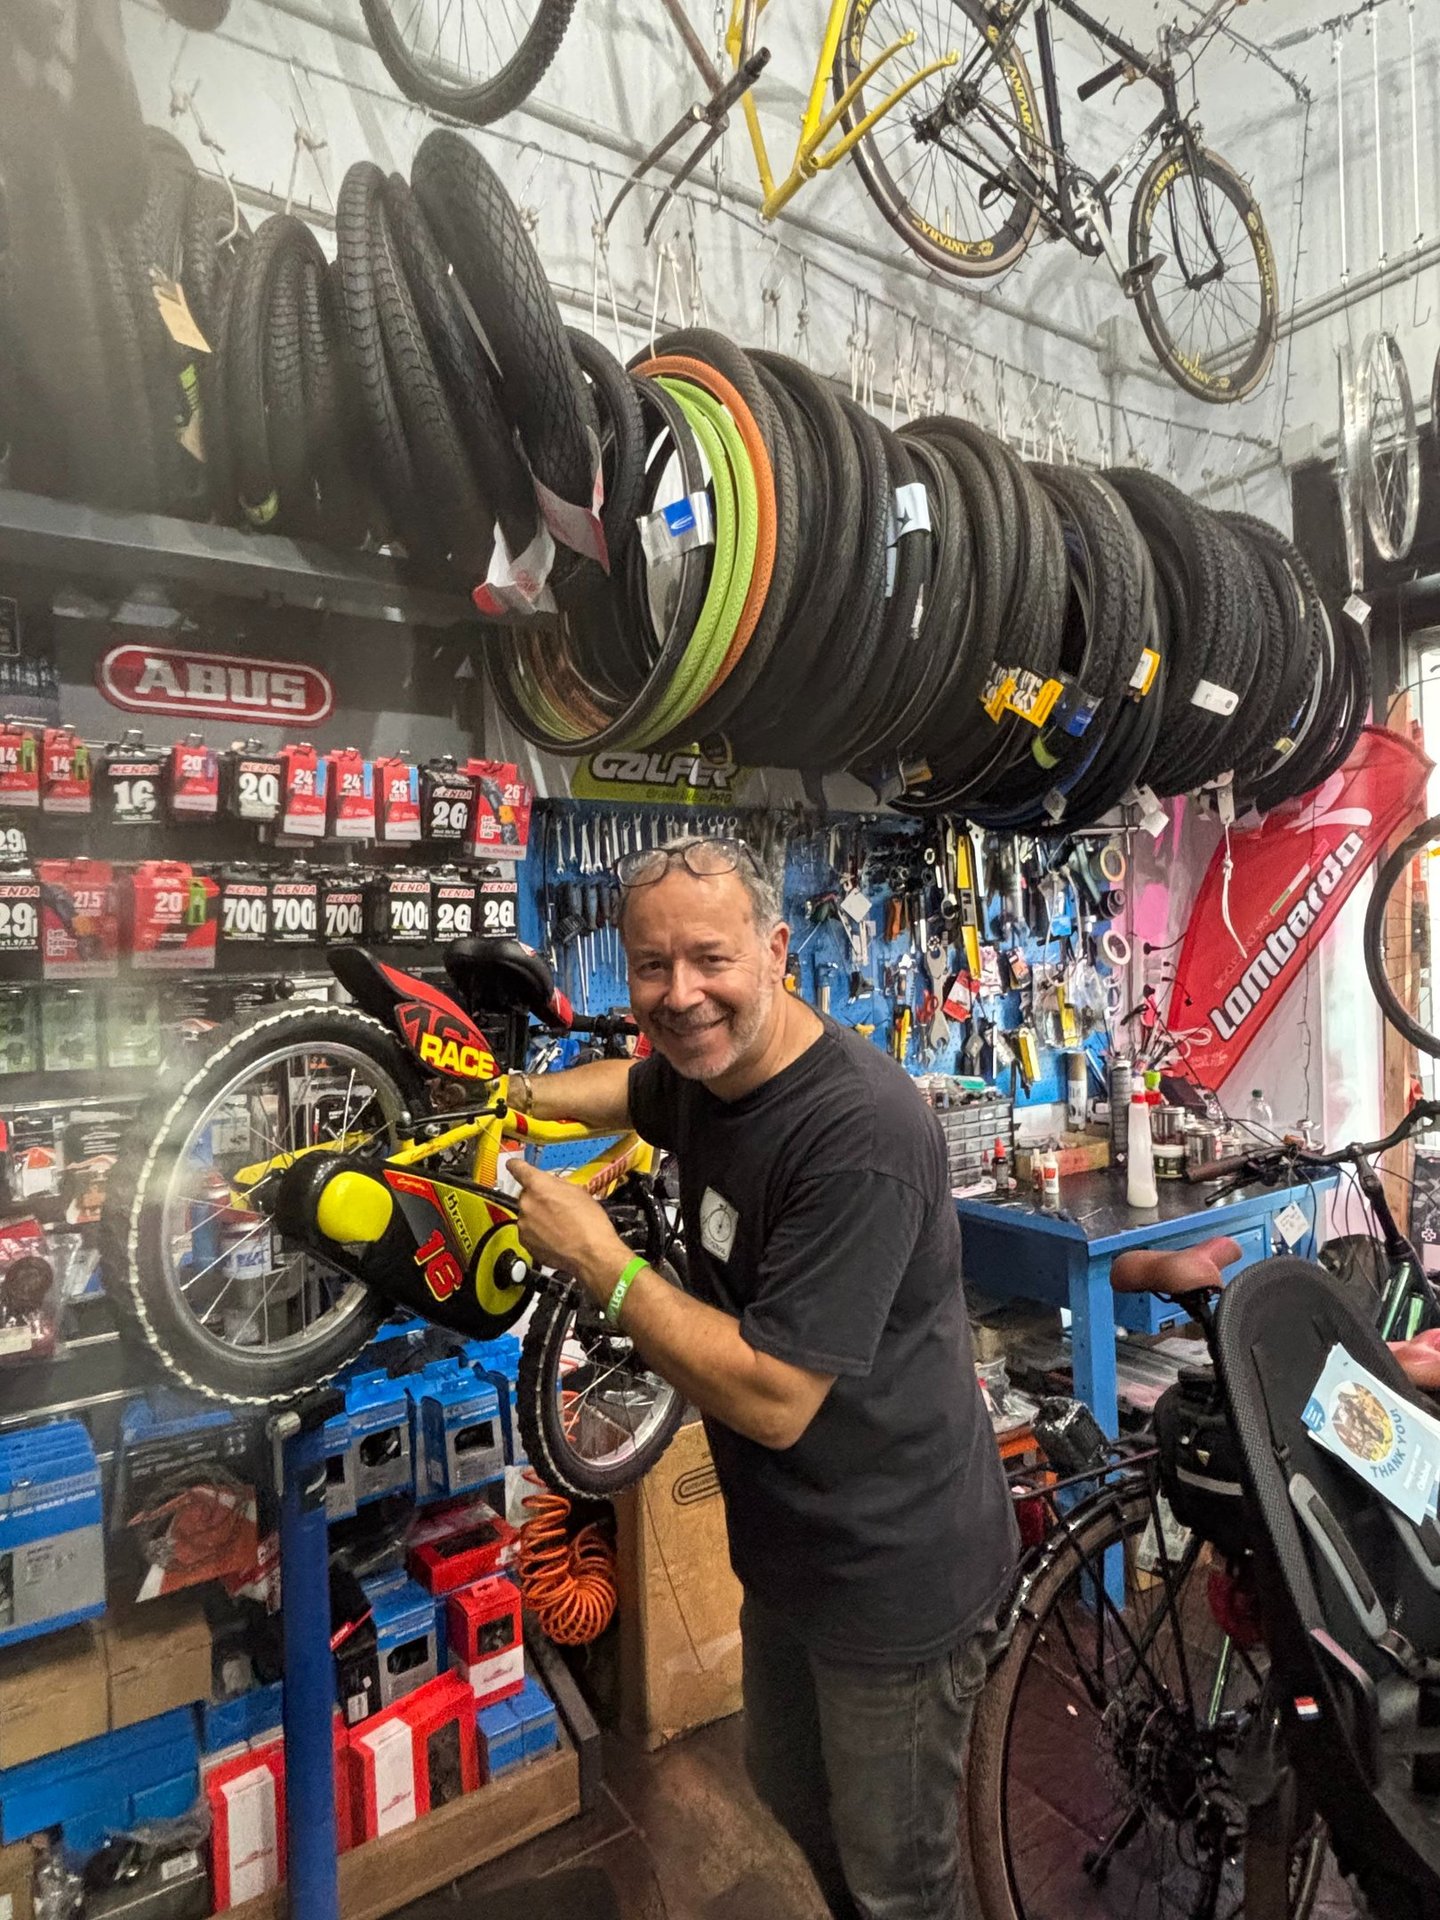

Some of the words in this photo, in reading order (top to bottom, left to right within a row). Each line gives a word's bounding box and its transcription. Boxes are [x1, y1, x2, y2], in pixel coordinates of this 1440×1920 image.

[135, 658, 306, 709] ABUS
[50, 755, 70, 772] 14
[108, 764, 160, 776] KENDA
[181, 755, 202, 771] 20
[239, 762, 281, 774] KENDA
[592, 753, 737, 787] GALFER
[294, 769, 314, 786] 24
[343, 774, 361, 790] 24
[239, 773, 280, 806] 20
[391, 780, 408, 795] 26
[504, 784, 524, 800] 26
[113, 780, 157, 813] 16
[0, 886, 40, 898] ENDA
[225, 885, 267, 896] KENDA
[273, 884, 317, 895] KENDA
[389, 882, 430, 893] KENDA
[438, 888, 475, 898] KENDA
[480, 883, 518, 893] KENDA
[74, 891, 101, 908] 27.5
[155, 892, 183, 912] 20
[326, 894, 363, 903] KENDA
[420, 1032, 495, 1080] RACE
[414, 1229, 464, 1302] 16
[1370, 1451, 1407, 1478] THANK
